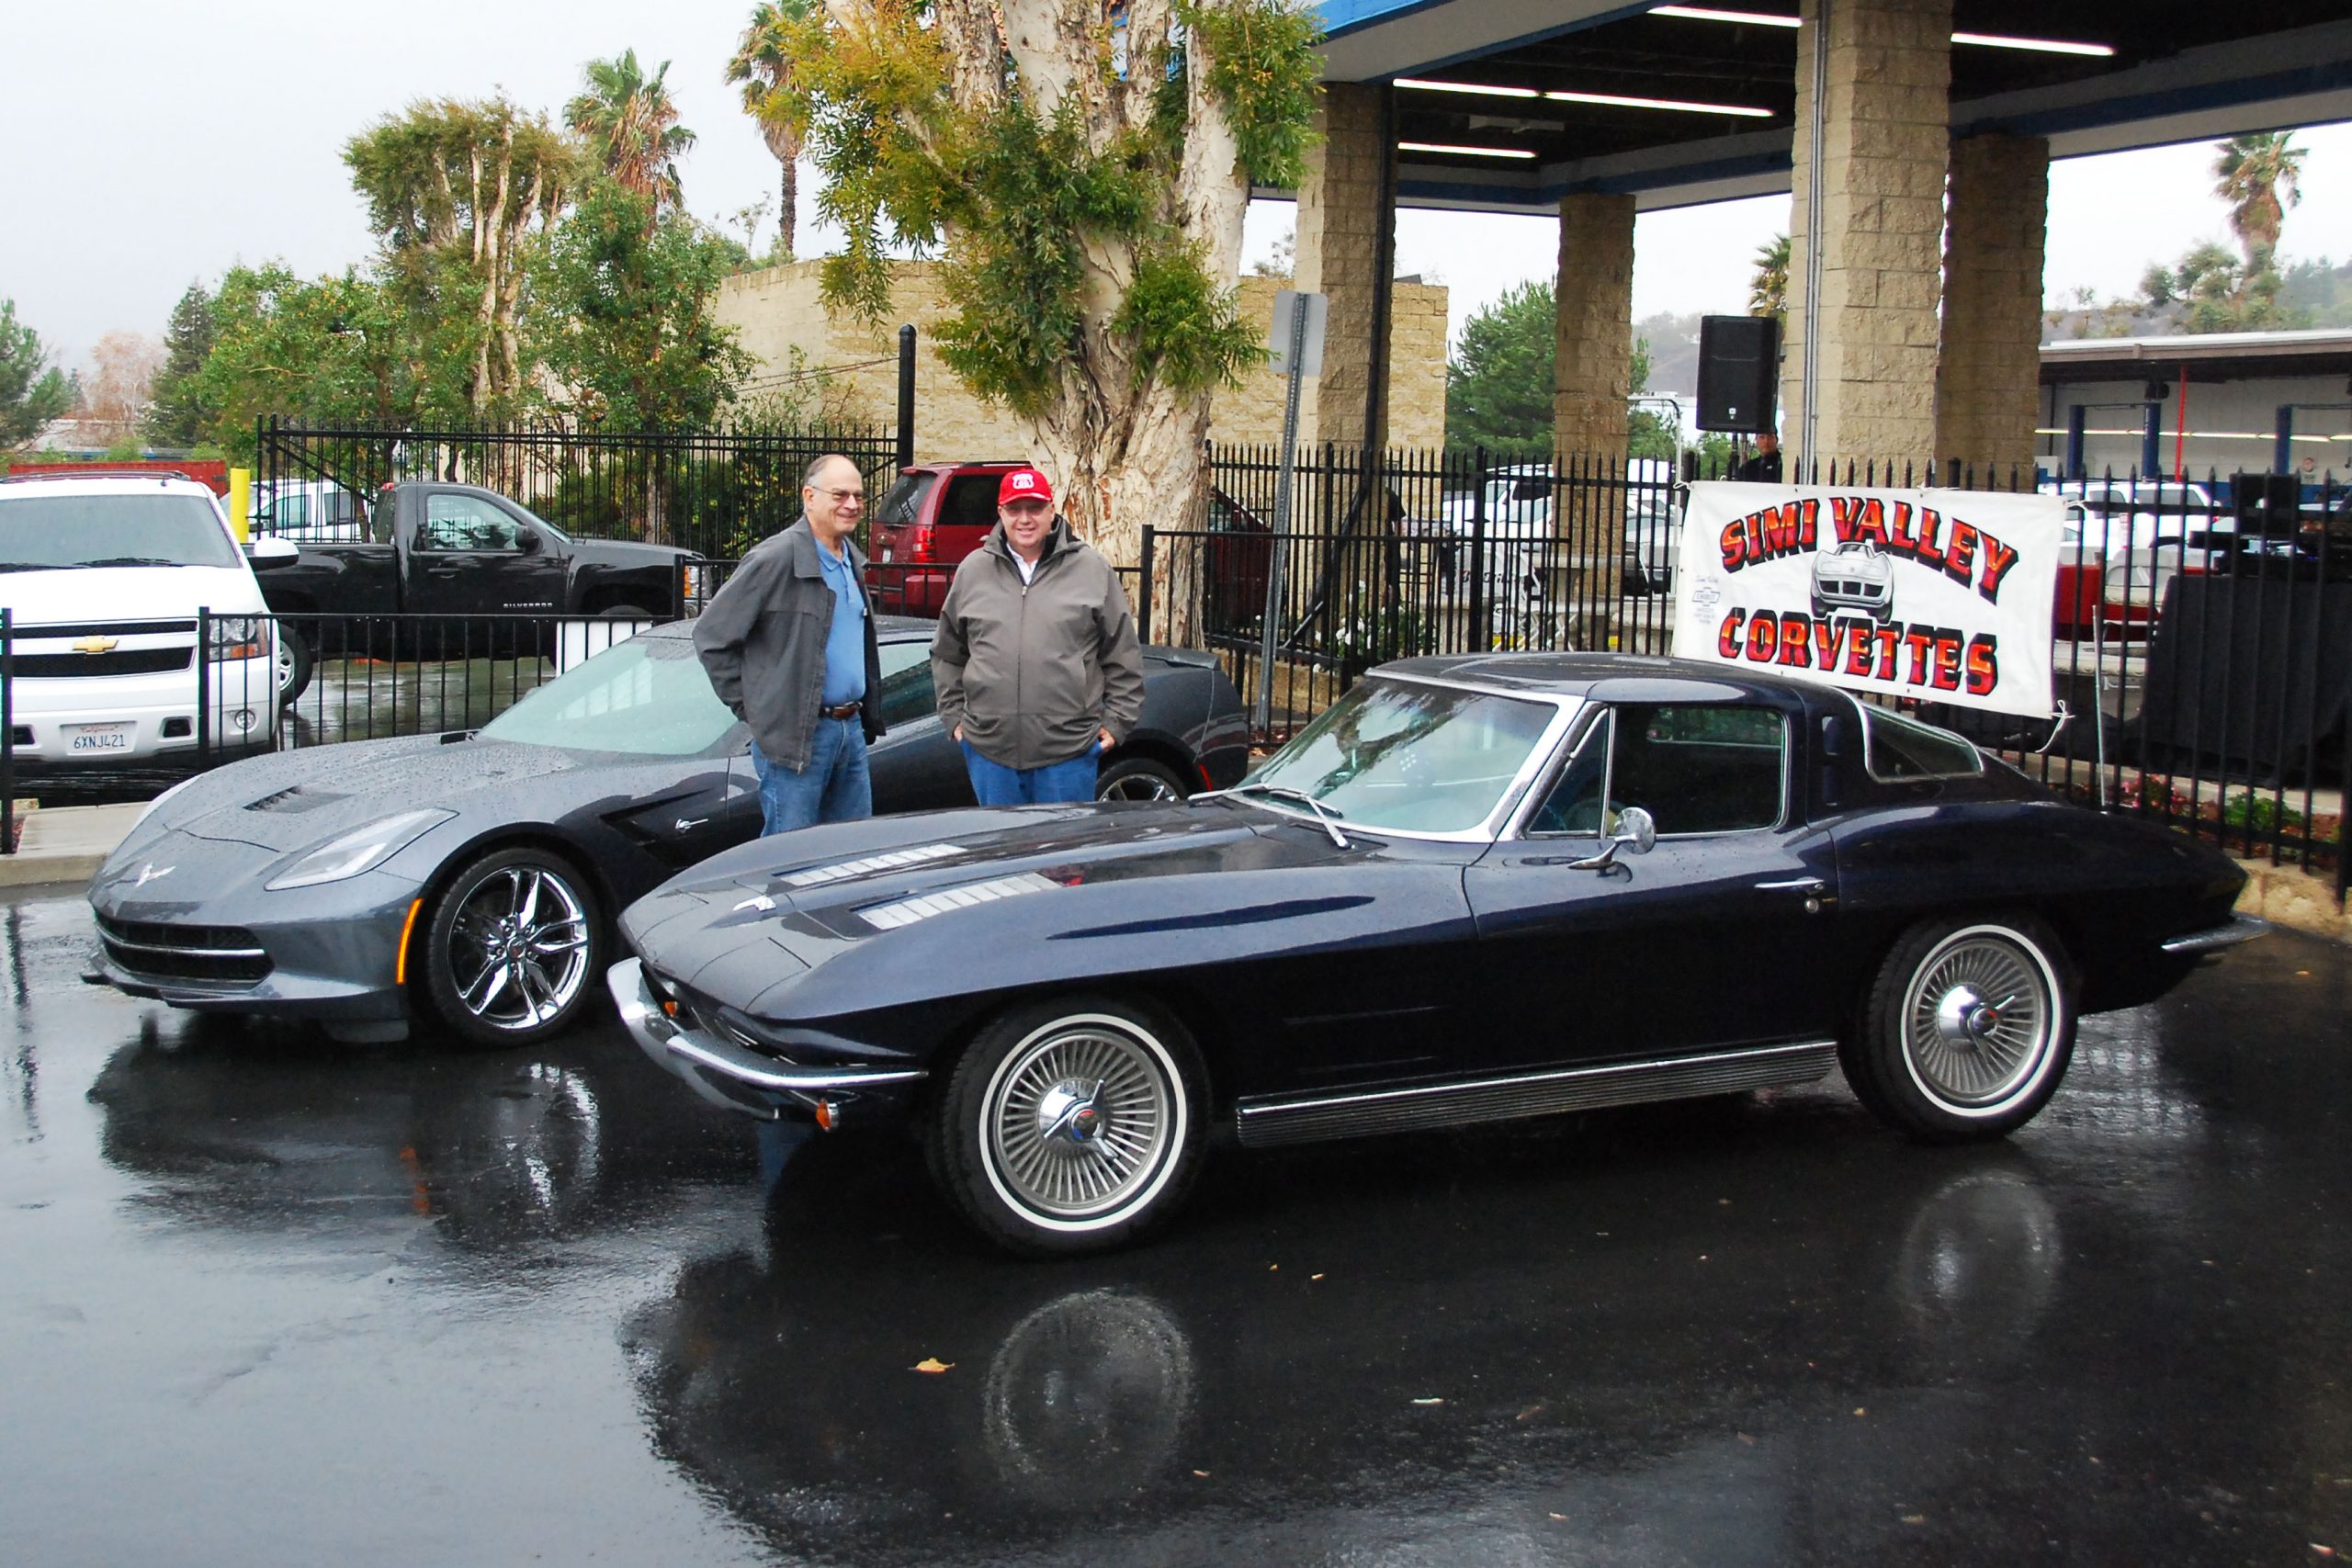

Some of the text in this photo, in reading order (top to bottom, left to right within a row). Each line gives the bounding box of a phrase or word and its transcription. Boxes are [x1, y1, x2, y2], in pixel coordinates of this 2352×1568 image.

[1720, 496, 2018, 605] SIMI VALLEY
[1718, 607, 1998, 696] CORVETTES
[74, 734, 126, 749] 6XNJ421
